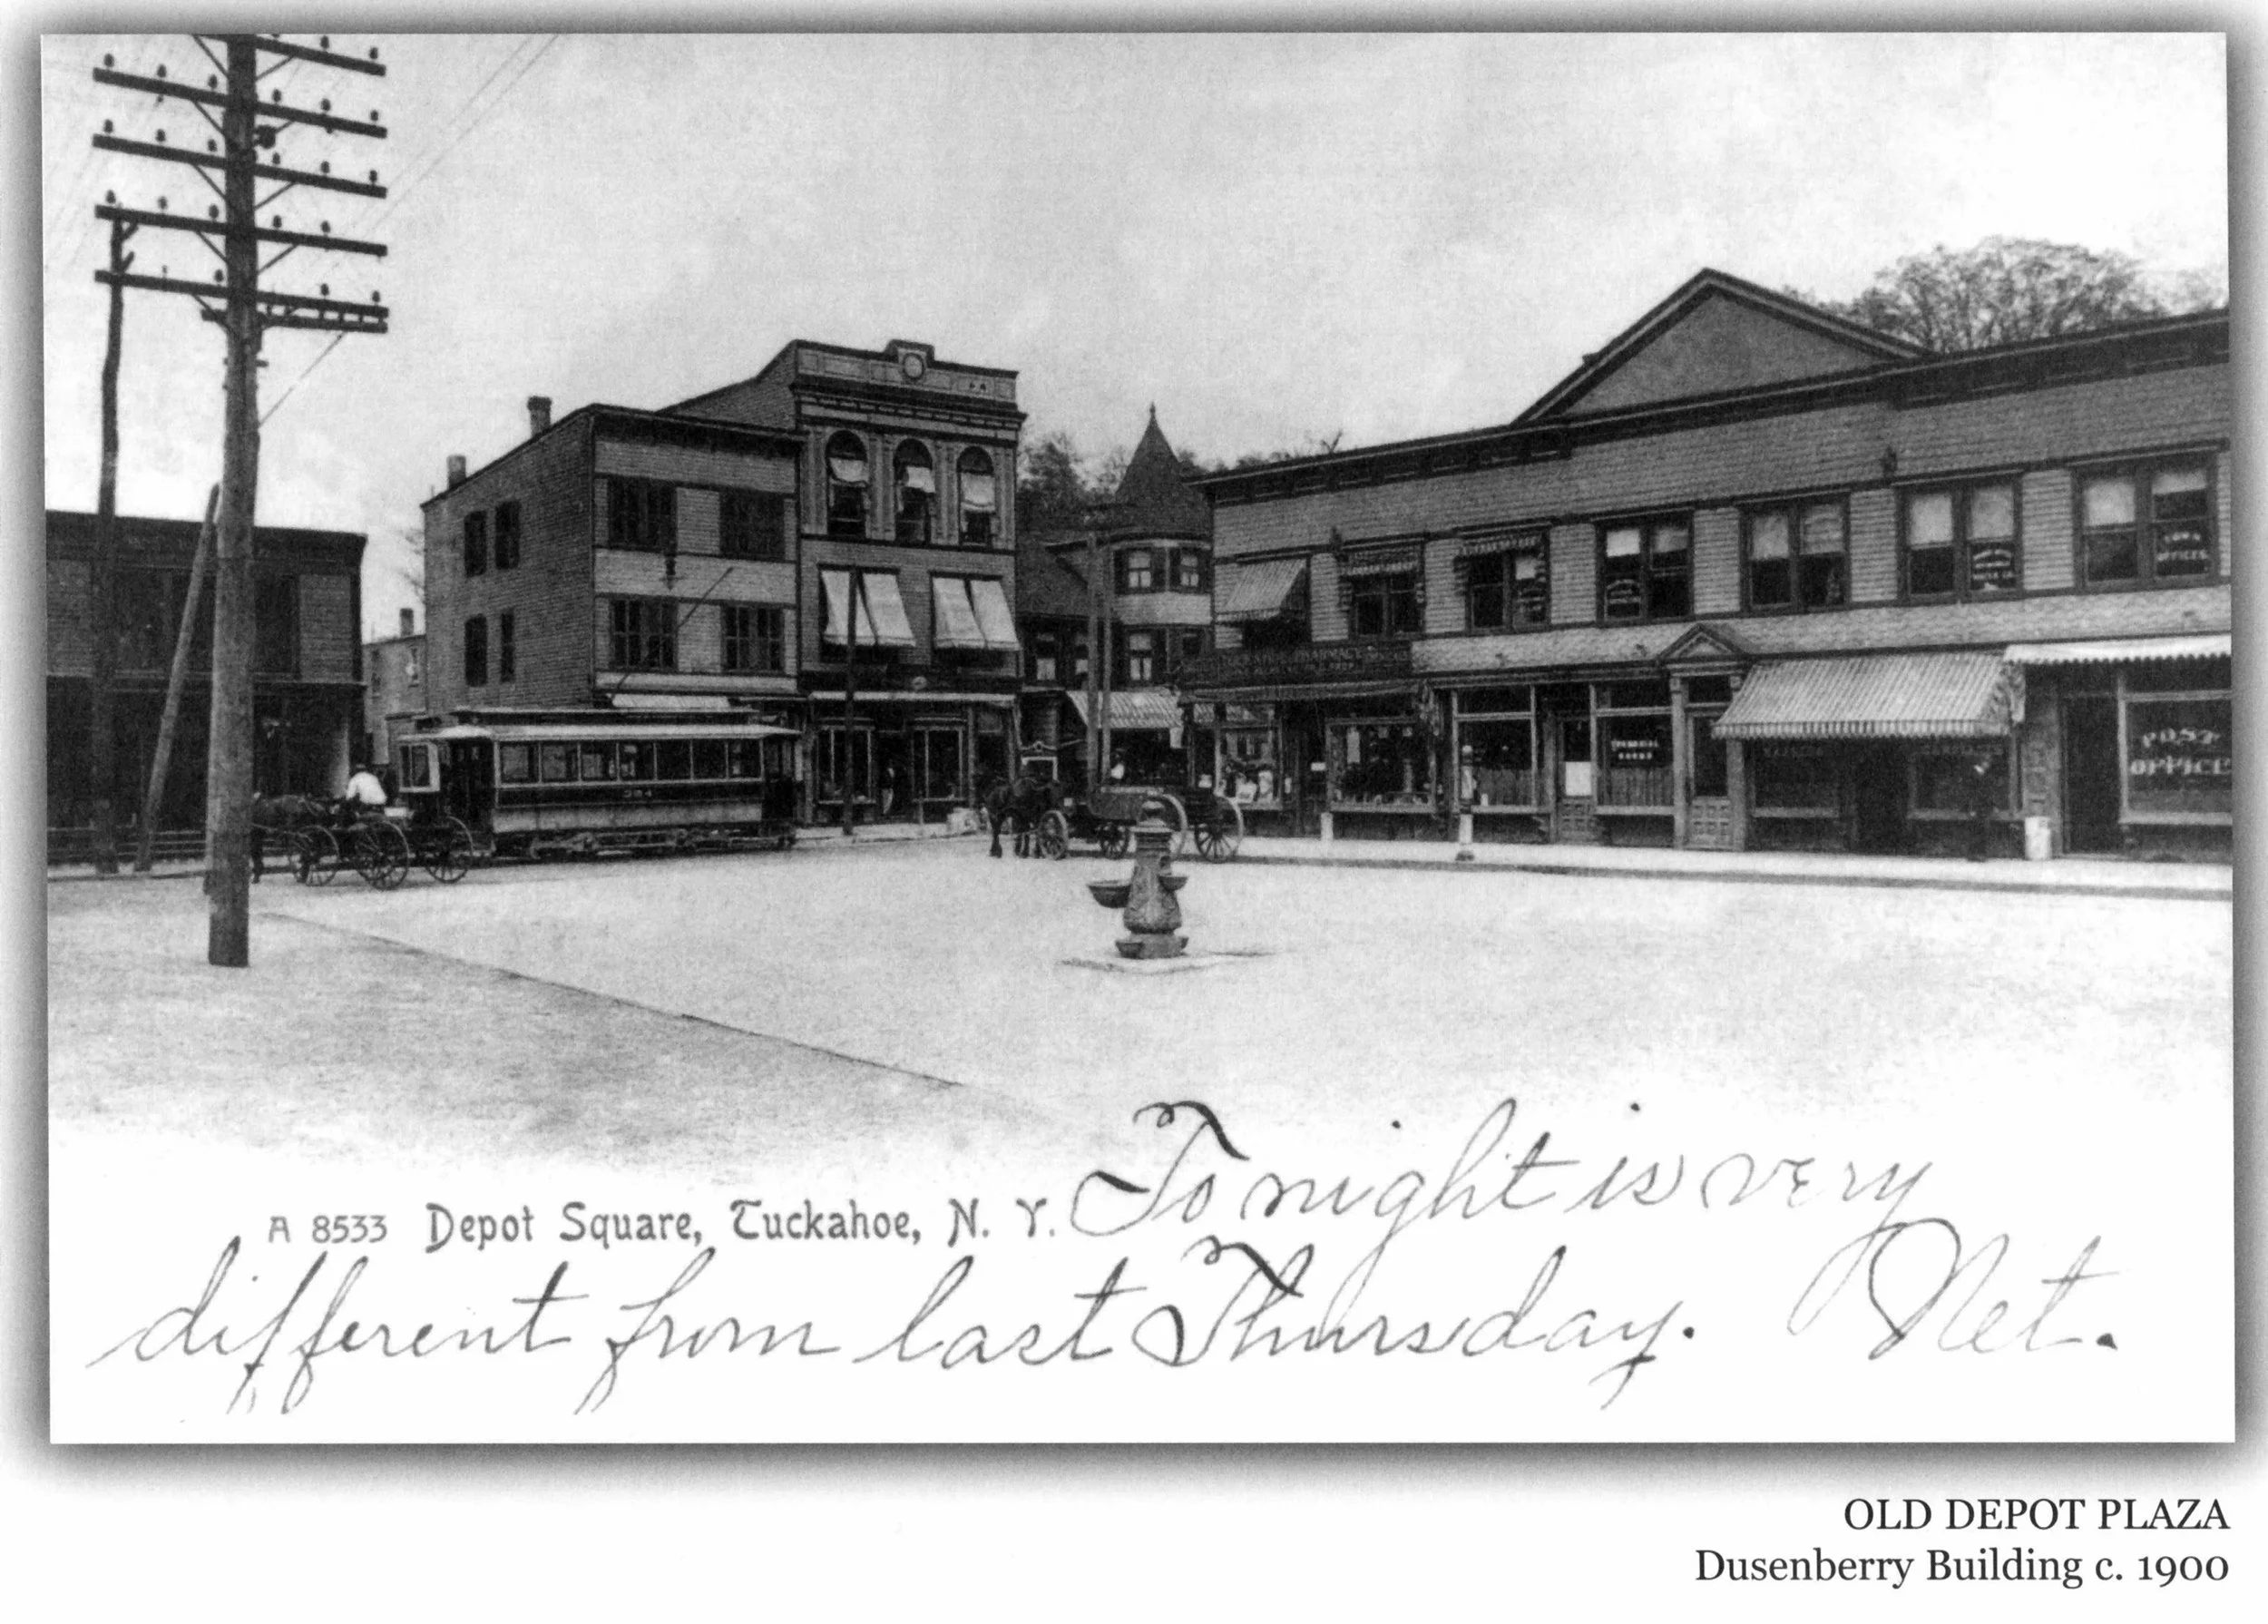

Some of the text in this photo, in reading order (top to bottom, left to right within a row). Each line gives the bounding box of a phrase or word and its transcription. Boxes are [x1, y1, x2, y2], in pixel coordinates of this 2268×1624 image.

[2141, 727, 2221, 748] POST
[1563, 1102, 1684, 1212] is
[1702, 1153, 1933, 1335] very
[86, 1236, 590, 1415] different
[573, 1247, 841, 1415] from
[853, 1255, 1148, 1370] last
[1132, 1234, 1695, 1410] Thursday.
